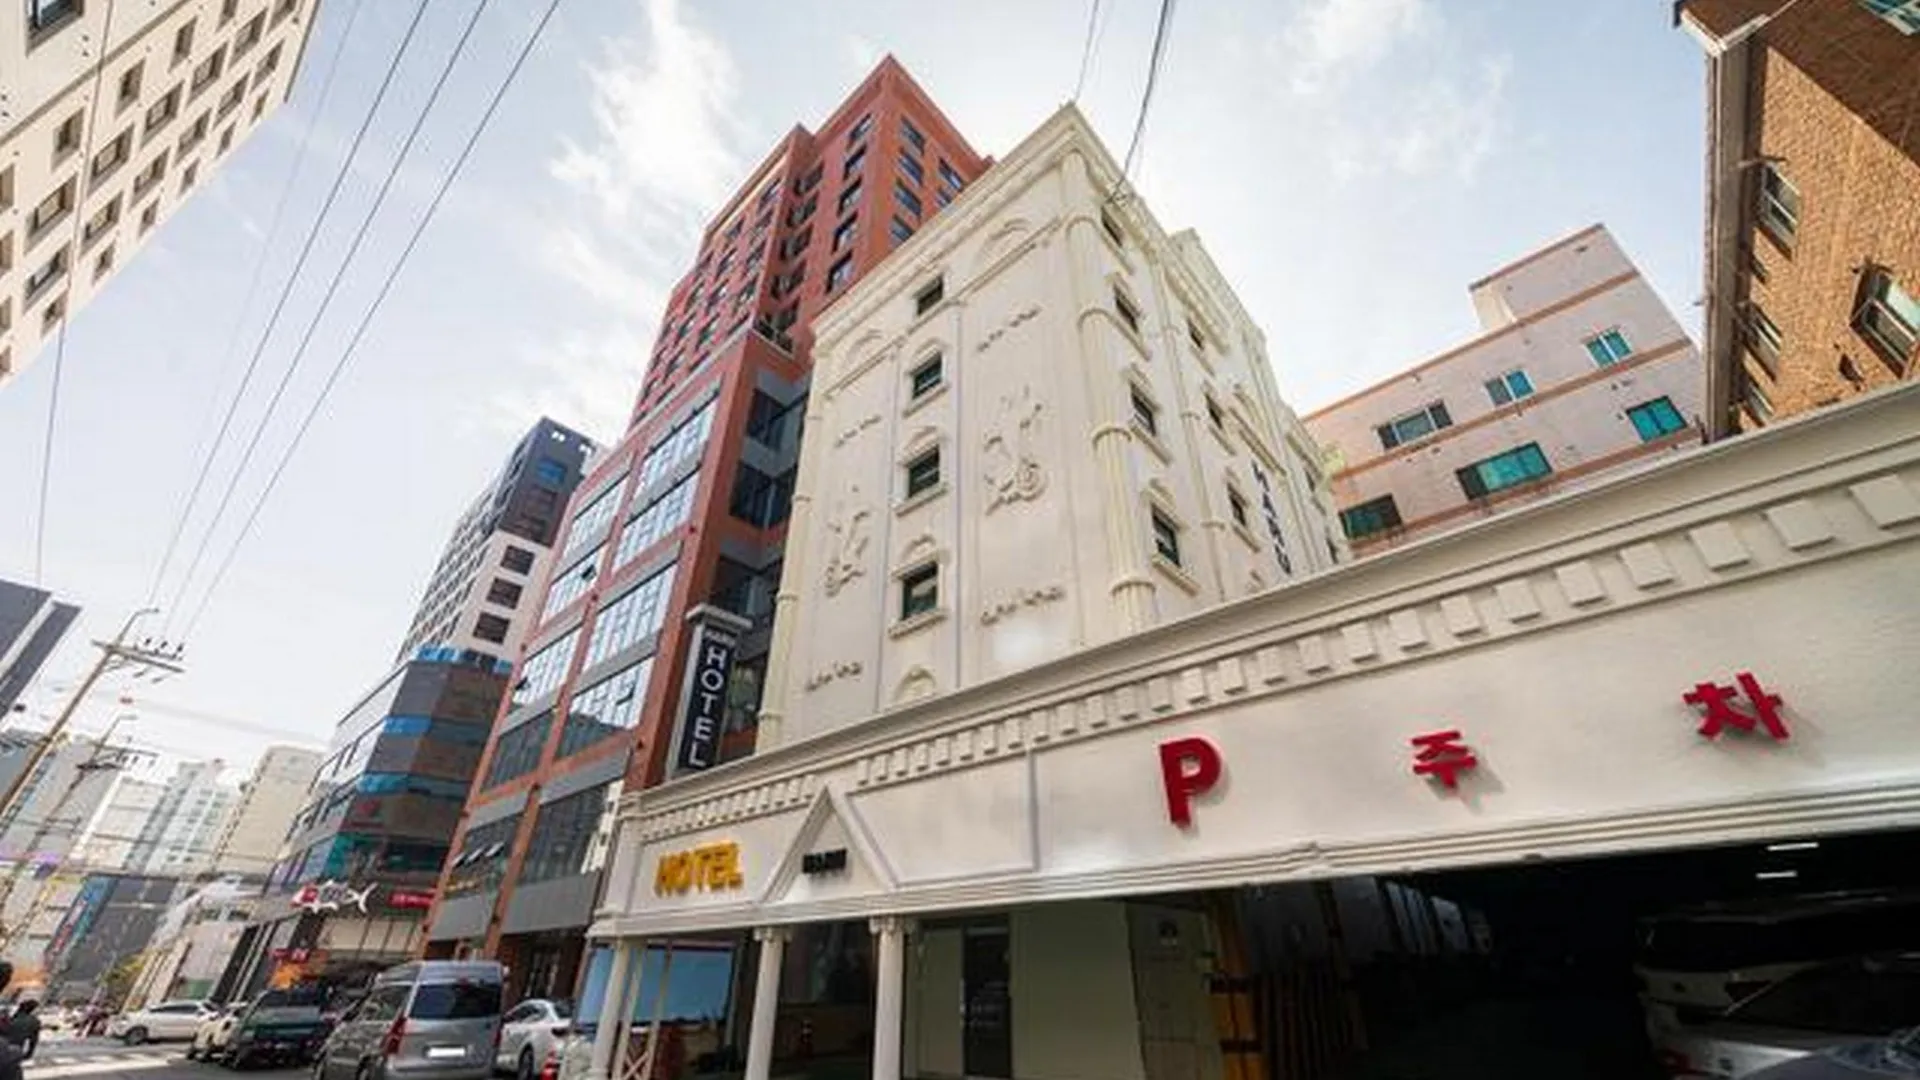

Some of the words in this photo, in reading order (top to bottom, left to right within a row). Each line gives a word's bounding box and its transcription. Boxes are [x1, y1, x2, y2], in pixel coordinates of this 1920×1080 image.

[688, 646, 728, 768] HOTEL
[1159, 737, 1221, 827] P
[655, 842, 744, 897] HOTEL
